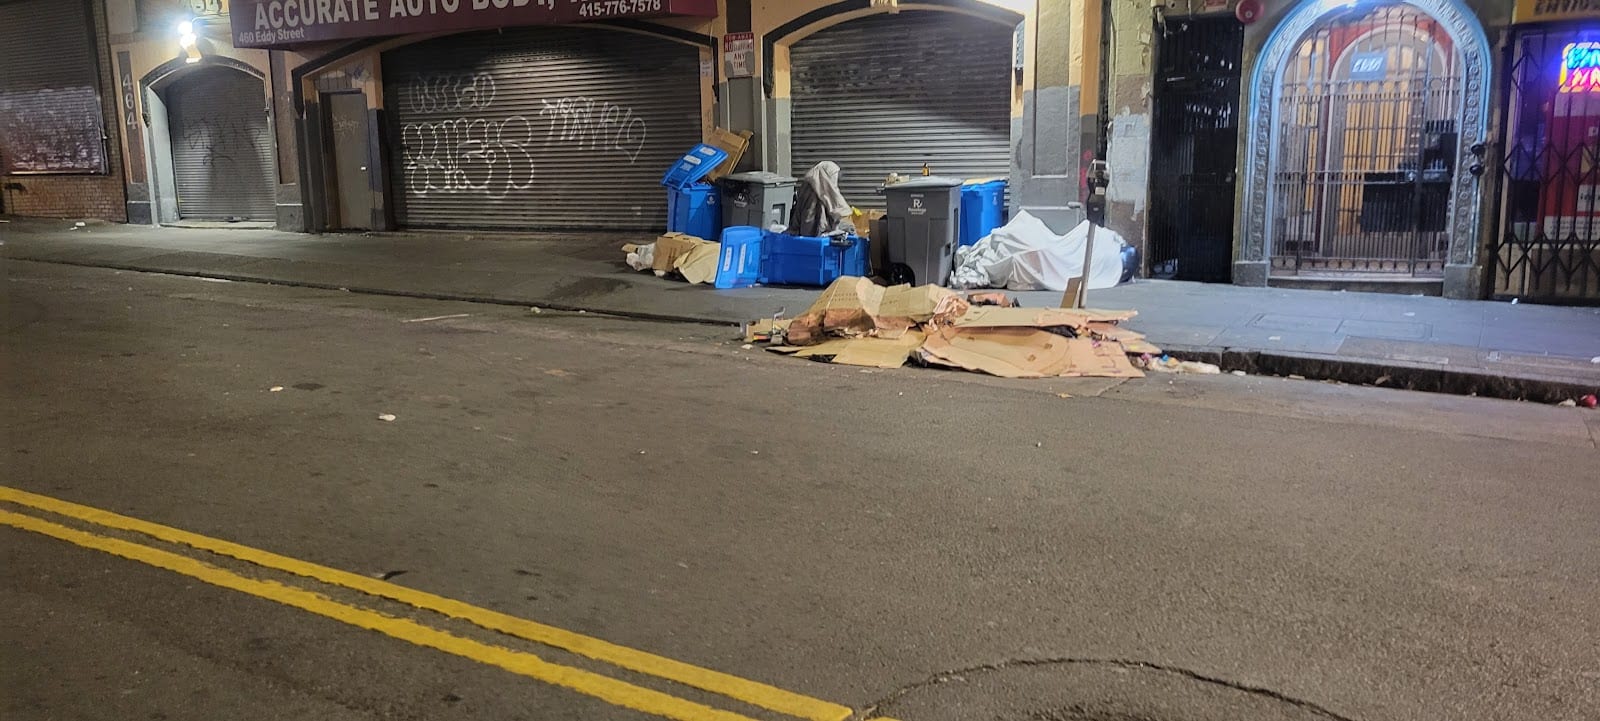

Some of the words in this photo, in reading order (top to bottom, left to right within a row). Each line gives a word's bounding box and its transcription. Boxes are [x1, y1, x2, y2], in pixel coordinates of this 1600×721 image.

[254, 0, 380, 30] ACCURATE
[579, 0, 661, 17] 415-776-7578
[239, 32, 254, 44] 460
[256, 30, 276, 44] Eddy
[278, 27, 304, 41] Street
[733, 53, 745, 61] ANY
